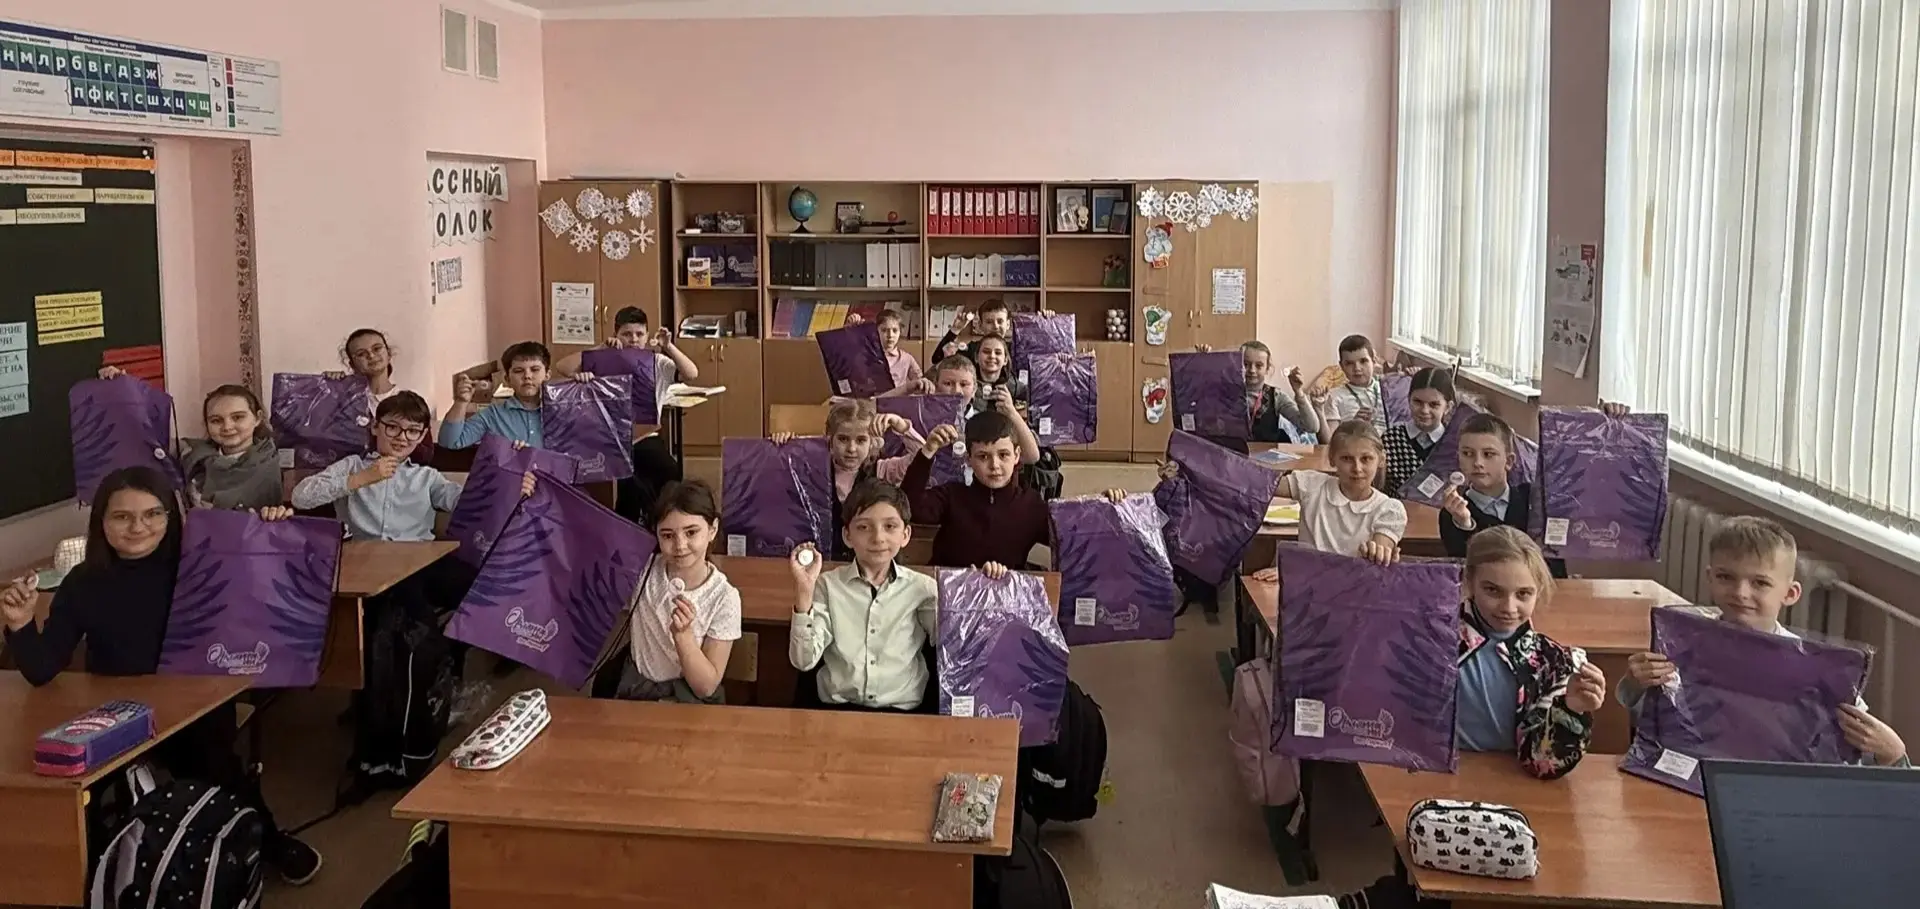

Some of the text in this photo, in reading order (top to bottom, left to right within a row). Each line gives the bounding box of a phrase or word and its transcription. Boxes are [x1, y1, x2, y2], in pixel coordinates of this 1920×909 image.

[56, 56, 66, 71] р
[71, 55, 82, 71] б
[88, 85, 101, 103] ф
[427, 165, 502, 196] ССНЫЙ
[436, 208, 493, 237] ОЛОК
